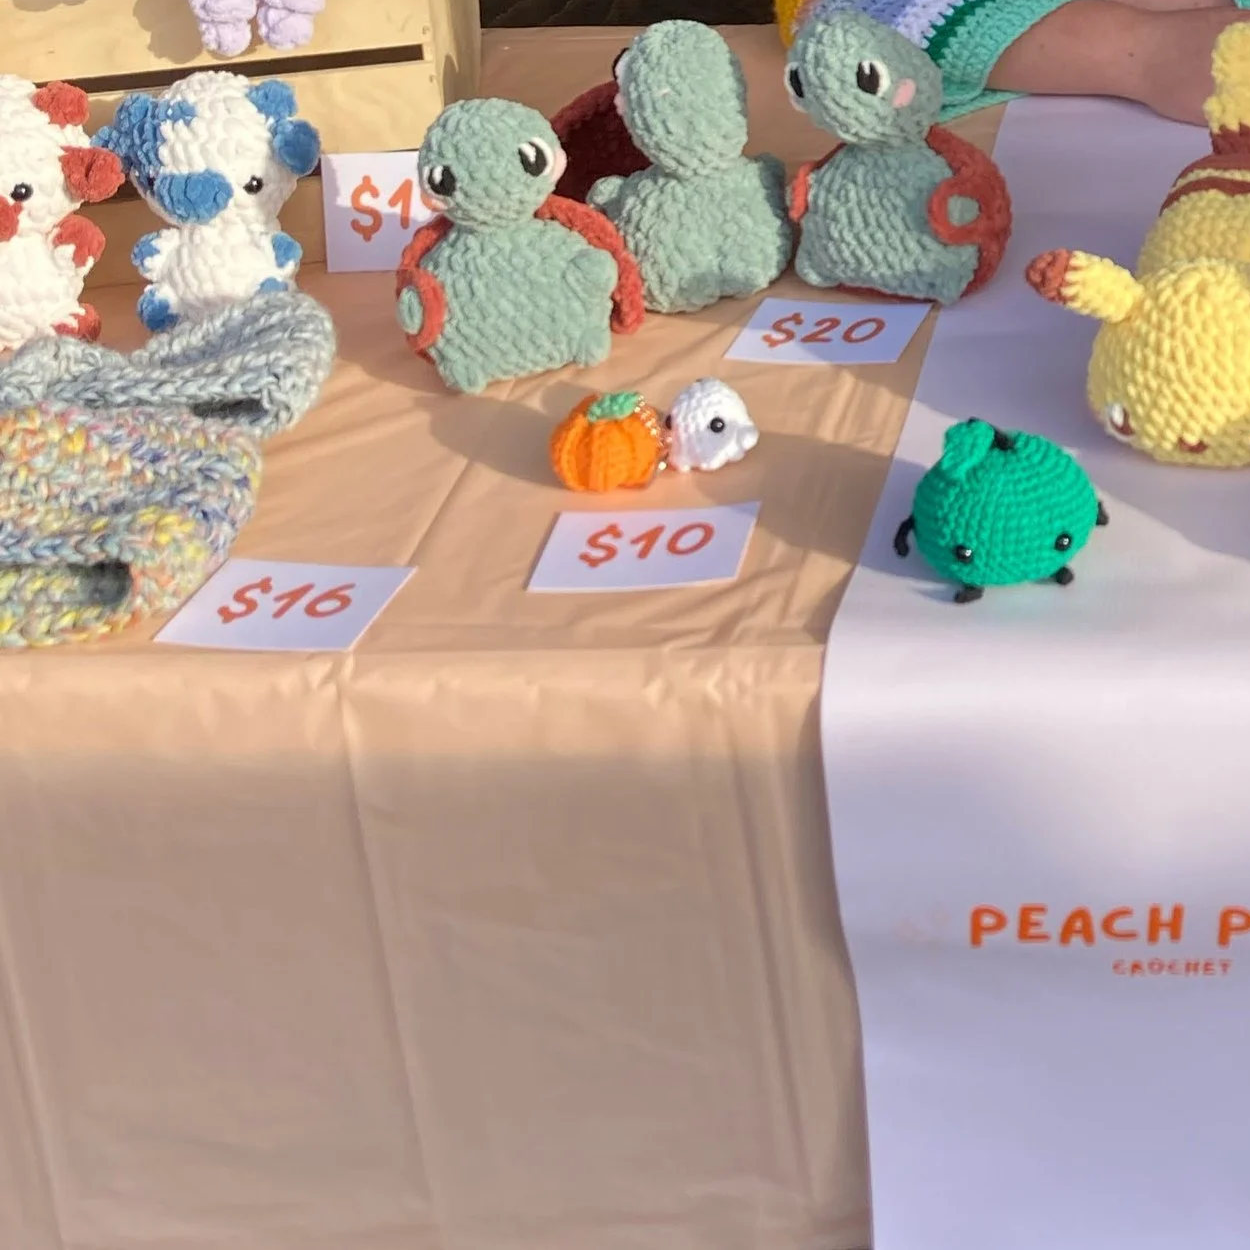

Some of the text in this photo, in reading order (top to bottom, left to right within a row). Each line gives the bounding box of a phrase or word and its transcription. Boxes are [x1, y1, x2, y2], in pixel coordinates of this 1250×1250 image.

[351, 175, 413, 242] $1
[762, 313, 886, 348] $20
[579, 523, 714, 568] $10
[218, 577, 356, 624] $16
[970, 904, 1184, 948] PEACH
[1113, 958, 1232, 977] CROCHET
